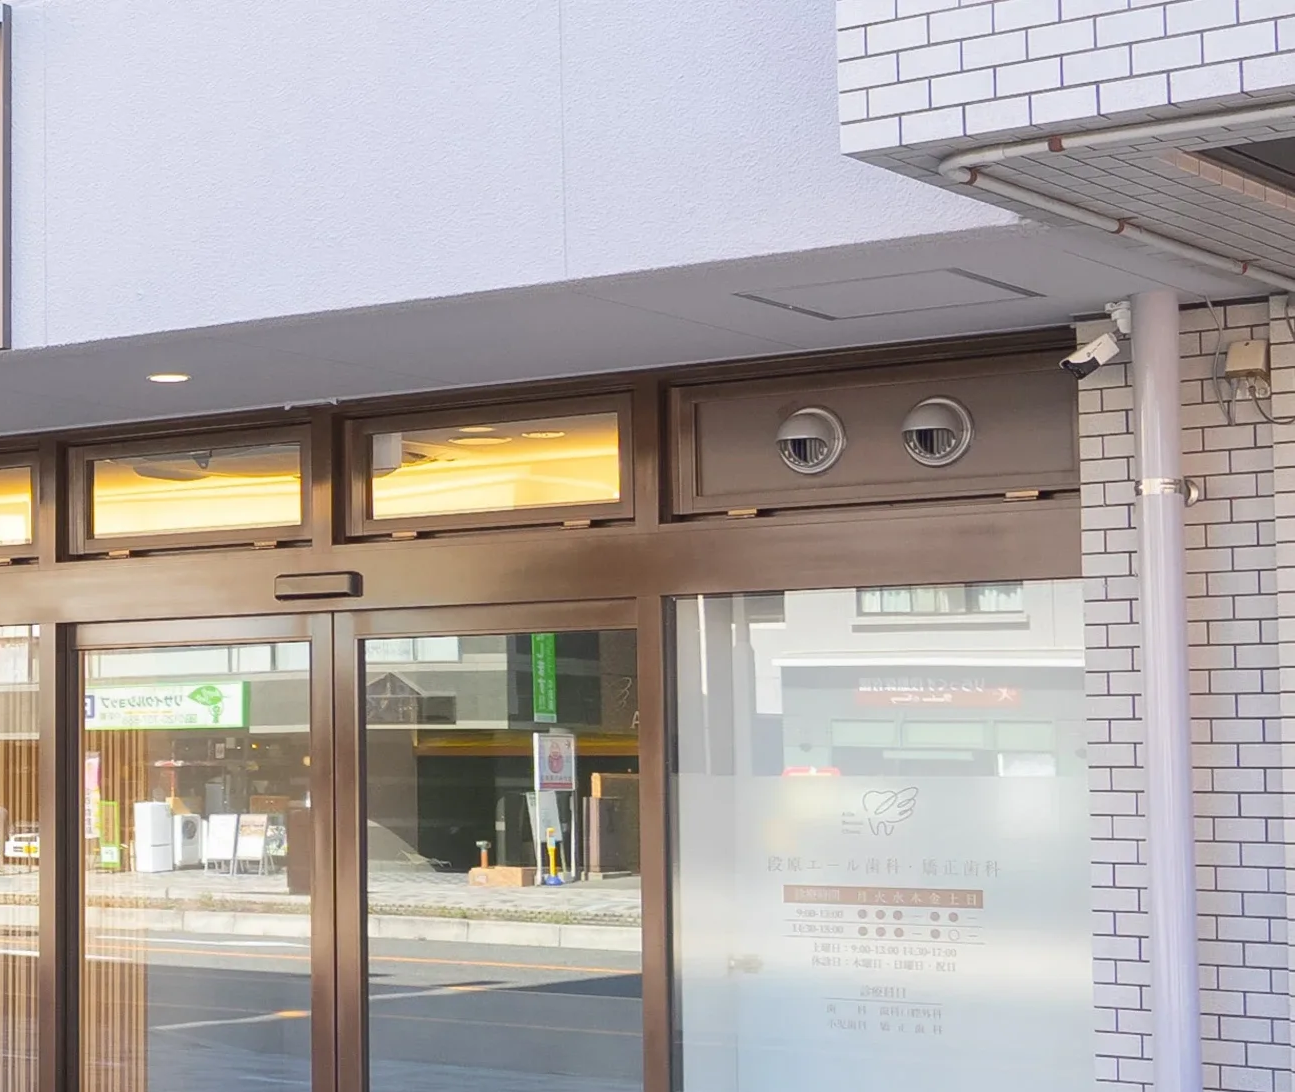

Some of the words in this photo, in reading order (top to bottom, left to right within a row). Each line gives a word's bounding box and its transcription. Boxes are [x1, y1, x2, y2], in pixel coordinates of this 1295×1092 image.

[766, 856, 1002, 878] 段原エール歯科・矯正歯科
[857, 891, 868, 902] 月
[874, 892, 886, 903] 火
[892, 892, 905, 903] 水
[910, 893, 923, 904] 木
[929, 893, 941, 905] 金
[948, 893, 960, 905] 土
[966, 894, 977, 906] 日
